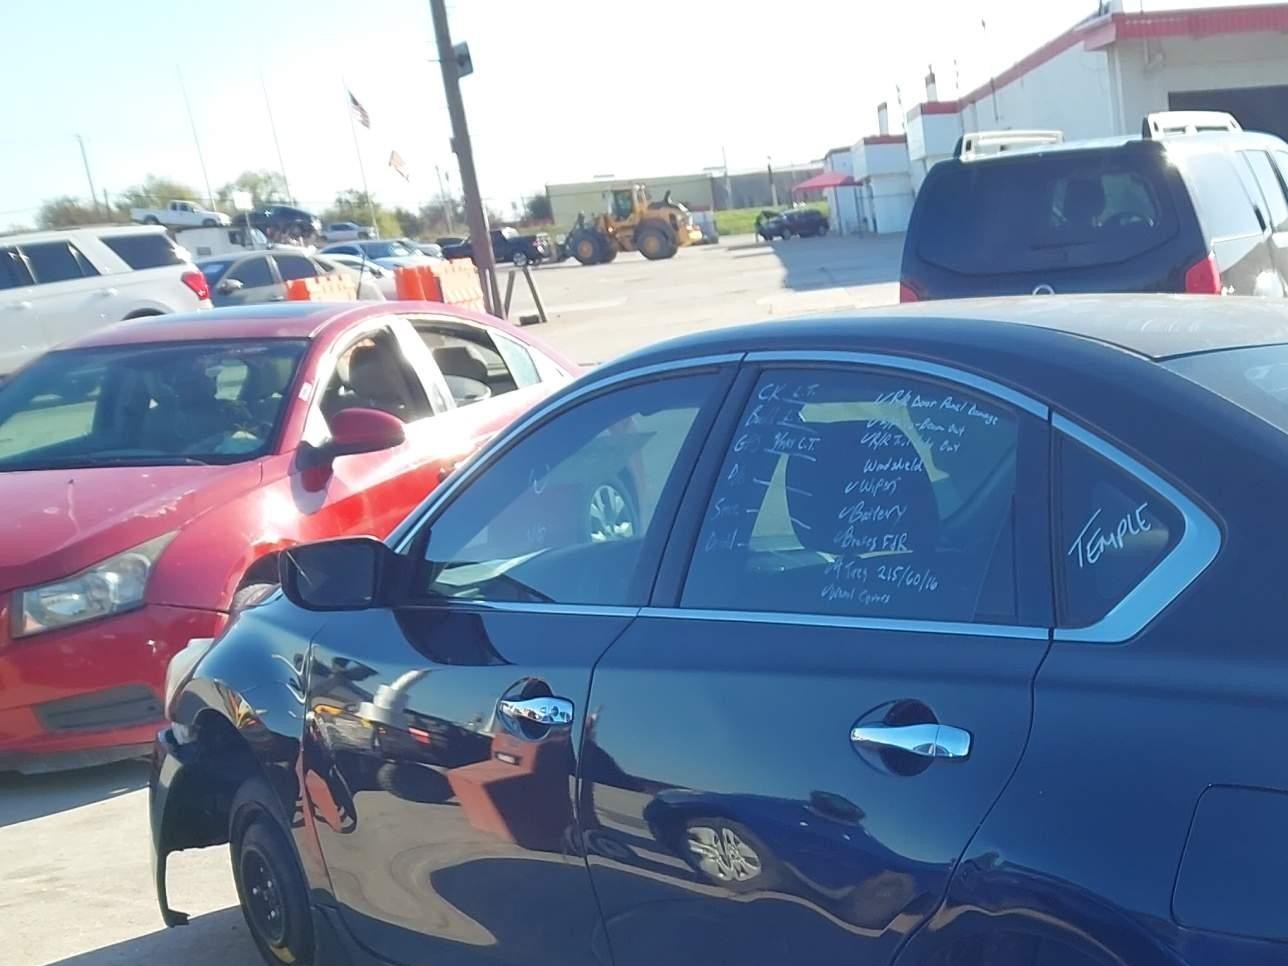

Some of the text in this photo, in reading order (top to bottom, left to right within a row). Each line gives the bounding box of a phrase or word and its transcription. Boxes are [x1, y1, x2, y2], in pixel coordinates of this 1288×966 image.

[911, 394, 938, 409] Door
[1067, 501, 1152, 569] TEMPLE
[876, 564, 939, 593] 215/60/16
